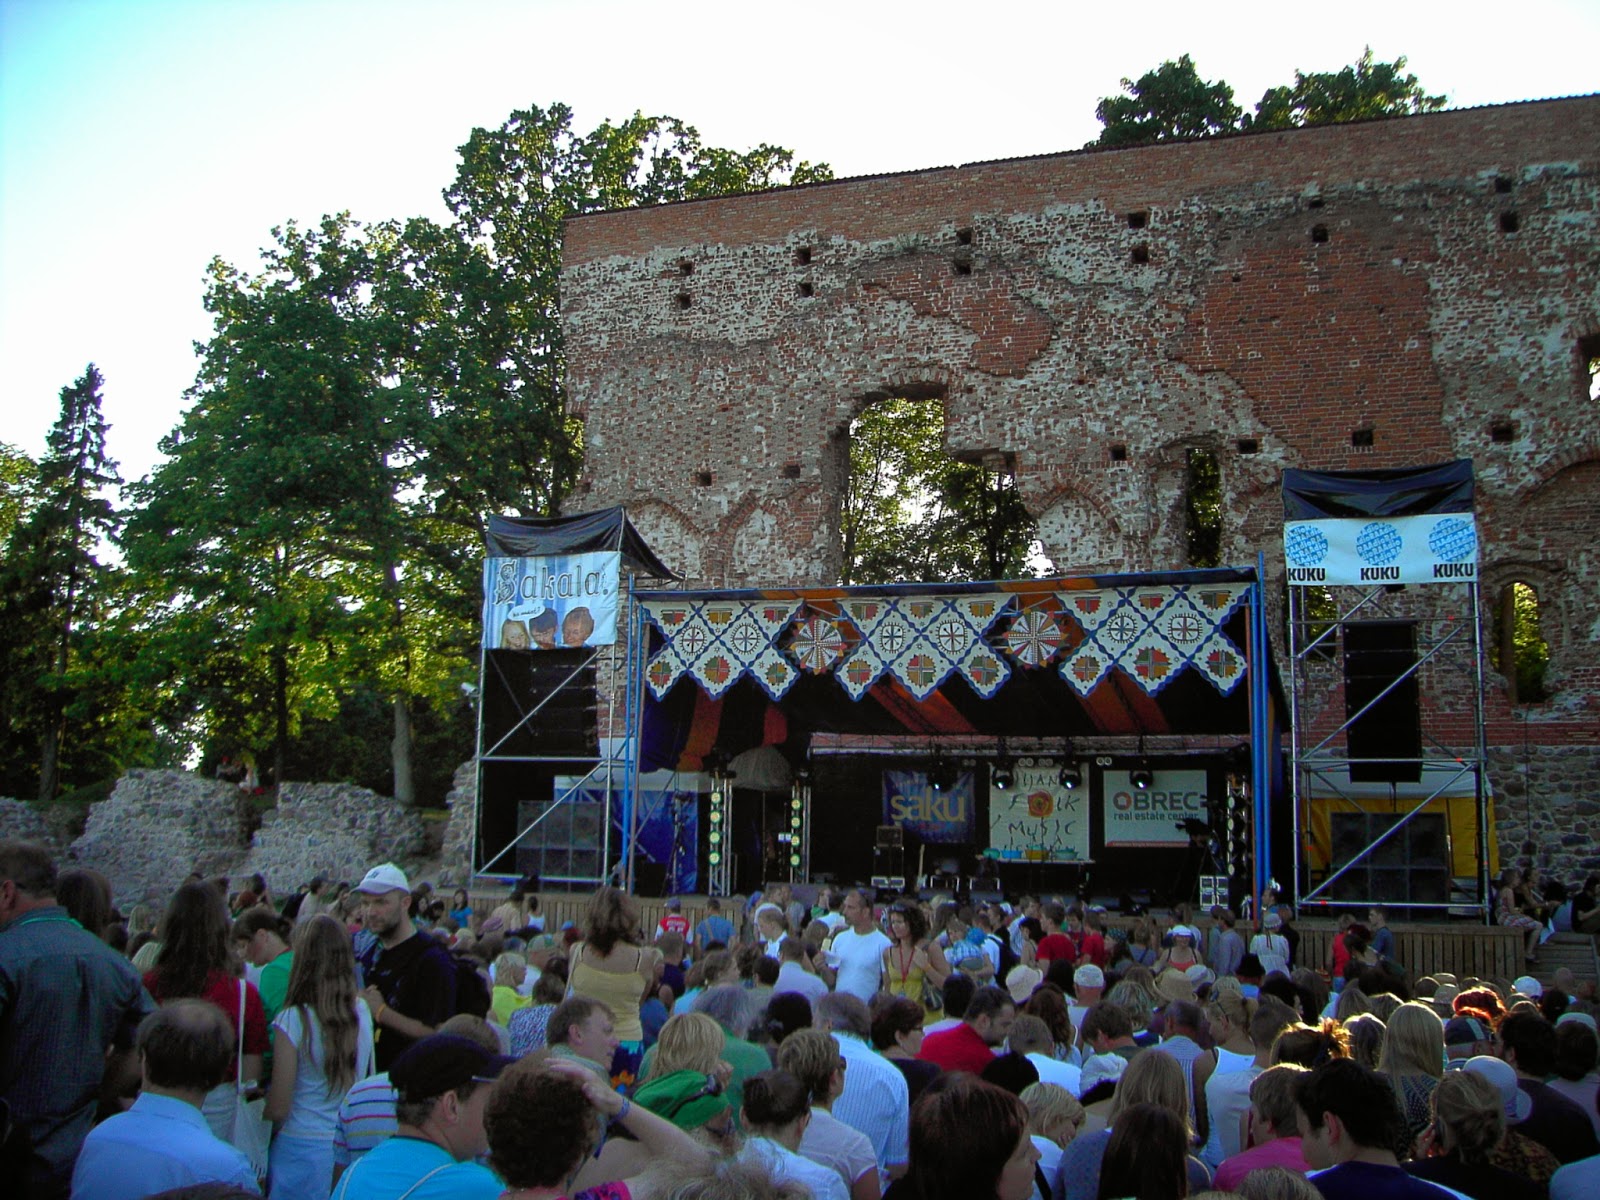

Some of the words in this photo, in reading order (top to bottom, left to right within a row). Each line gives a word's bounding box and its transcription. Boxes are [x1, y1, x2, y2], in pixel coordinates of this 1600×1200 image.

[1287, 568, 1326, 581] KUKU
[1360, 566, 1400, 581] KUKU
[1434, 563, 1474, 578] KUKU
[890, 786, 966, 822] saku
[1112, 791, 1199, 811] OBREC
[1114, 811, 1133, 820] real
[1135, 811, 1165, 820] estate
[1167, 811, 1199, 820] center
